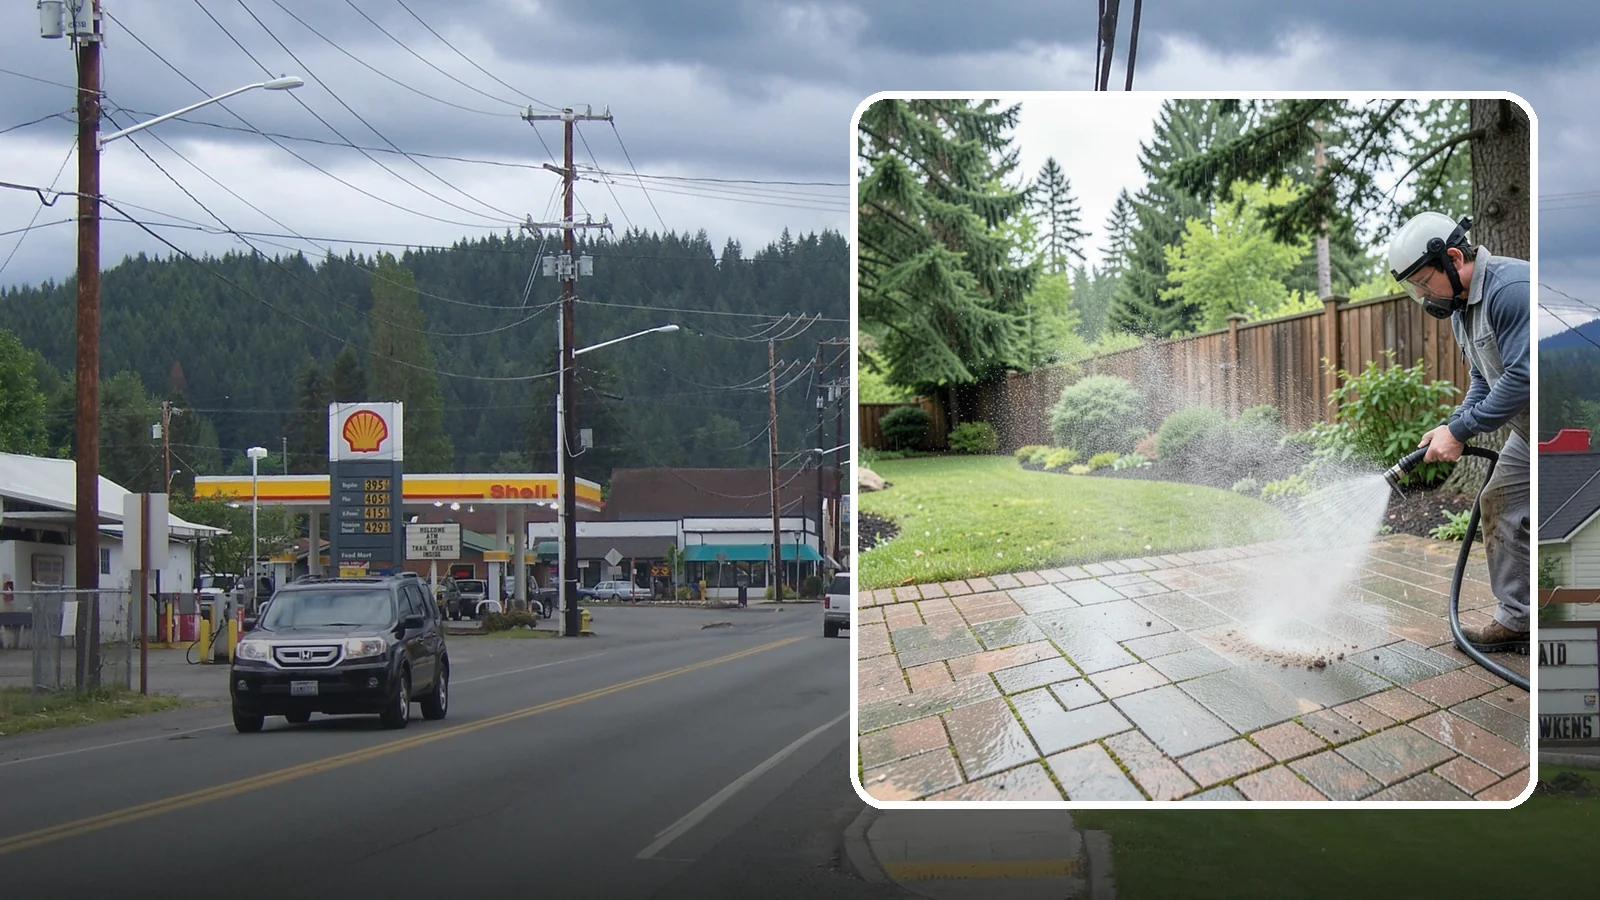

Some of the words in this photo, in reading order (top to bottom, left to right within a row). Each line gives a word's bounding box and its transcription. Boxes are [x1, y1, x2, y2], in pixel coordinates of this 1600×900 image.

[365, 480, 383, 490] 395
[490, 484, 547, 499] Shell
[365, 494, 383, 504] 405
[365, 508, 383, 518] 415
[365, 522, 383, 532] 429
